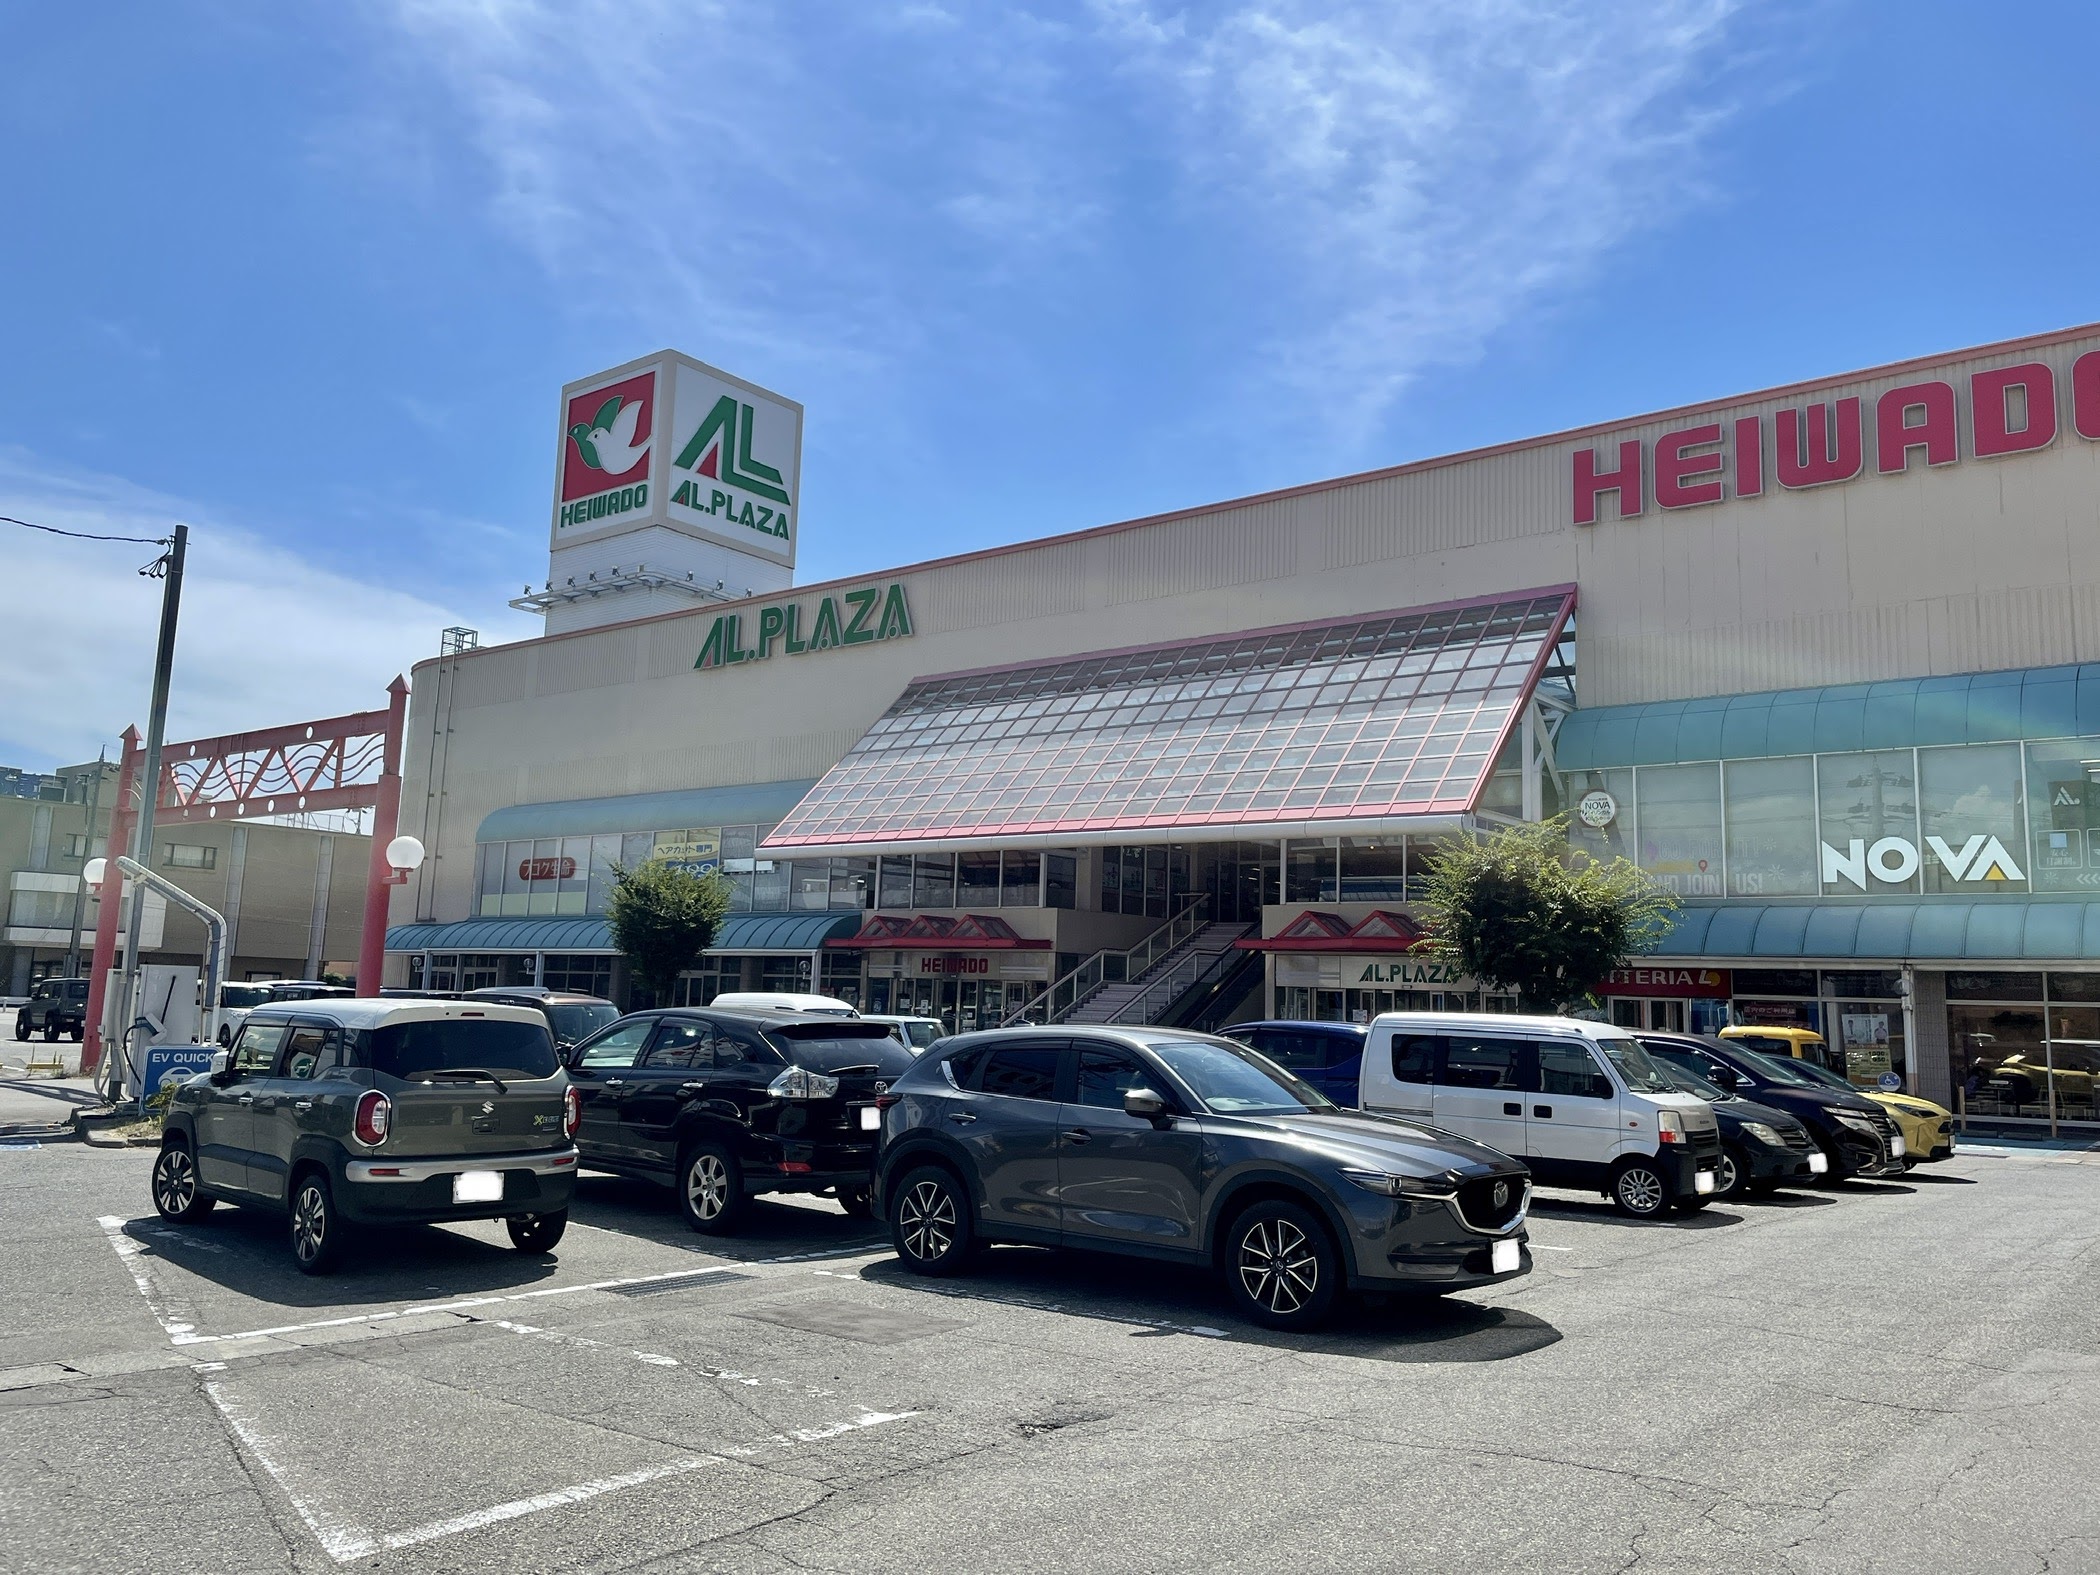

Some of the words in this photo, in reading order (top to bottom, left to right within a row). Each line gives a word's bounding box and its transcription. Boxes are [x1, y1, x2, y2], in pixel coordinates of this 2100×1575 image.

[560, 484, 648, 528] HEIWADO
[670, 480, 790, 540] AL.PLAZA
[693, 583, 914, 670] AL.PLAZA
[1584, 801, 1611, 810] NOVA
[1822, 834, 2027, 891] NOVA
[1687, 874, 1720, 894] JOIN
[1735, 873, 1763, 894] US!
[921, 957, 989, 974] HEIWADO
[1609, 969, 1694, 985] TTERIA
[152, 1053, 170, 1063] EV
[173, 1053, 214, 1063] QUICK
